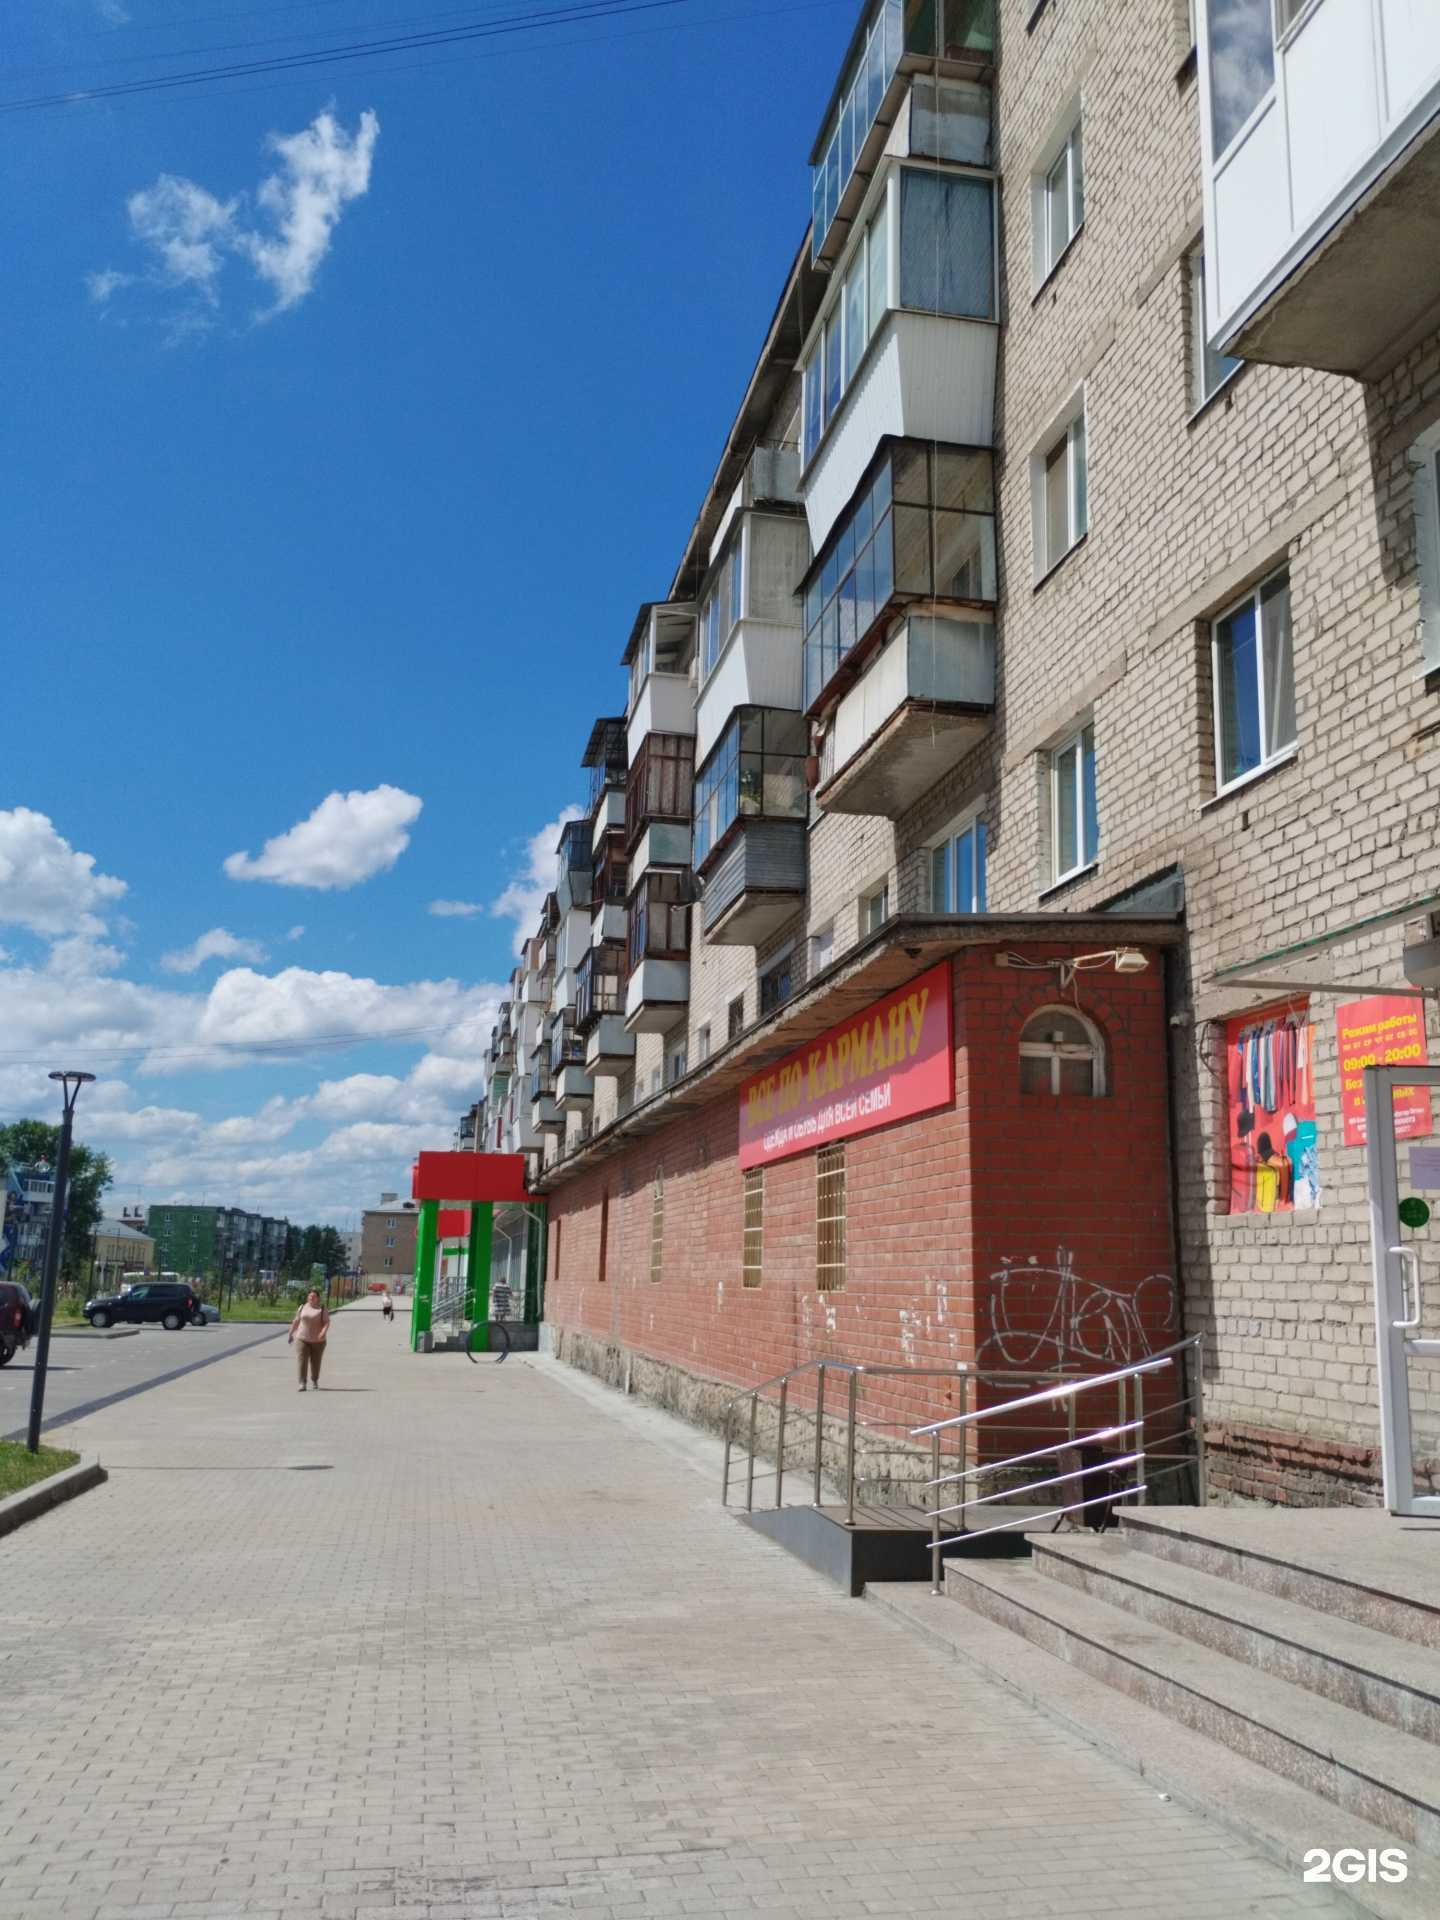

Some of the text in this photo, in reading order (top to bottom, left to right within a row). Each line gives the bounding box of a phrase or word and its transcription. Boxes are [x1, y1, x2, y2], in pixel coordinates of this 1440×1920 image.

[1343, 1014, 1417, 1040] Режим работы
[779, 1061, 802, 1115] ПО
[807, 988, 929, 1101] КАРМАНУ
[1343, 1053, 1376, 1071] 09:00
[1385, 1043, 1421, 1063] 20:00
[817, 1107, 834, 1134] ДЛЯ
[835, 1098, 858, 1124] ВСЕЙ
[858, 1082, 891, 1116] СЕМЬИ
